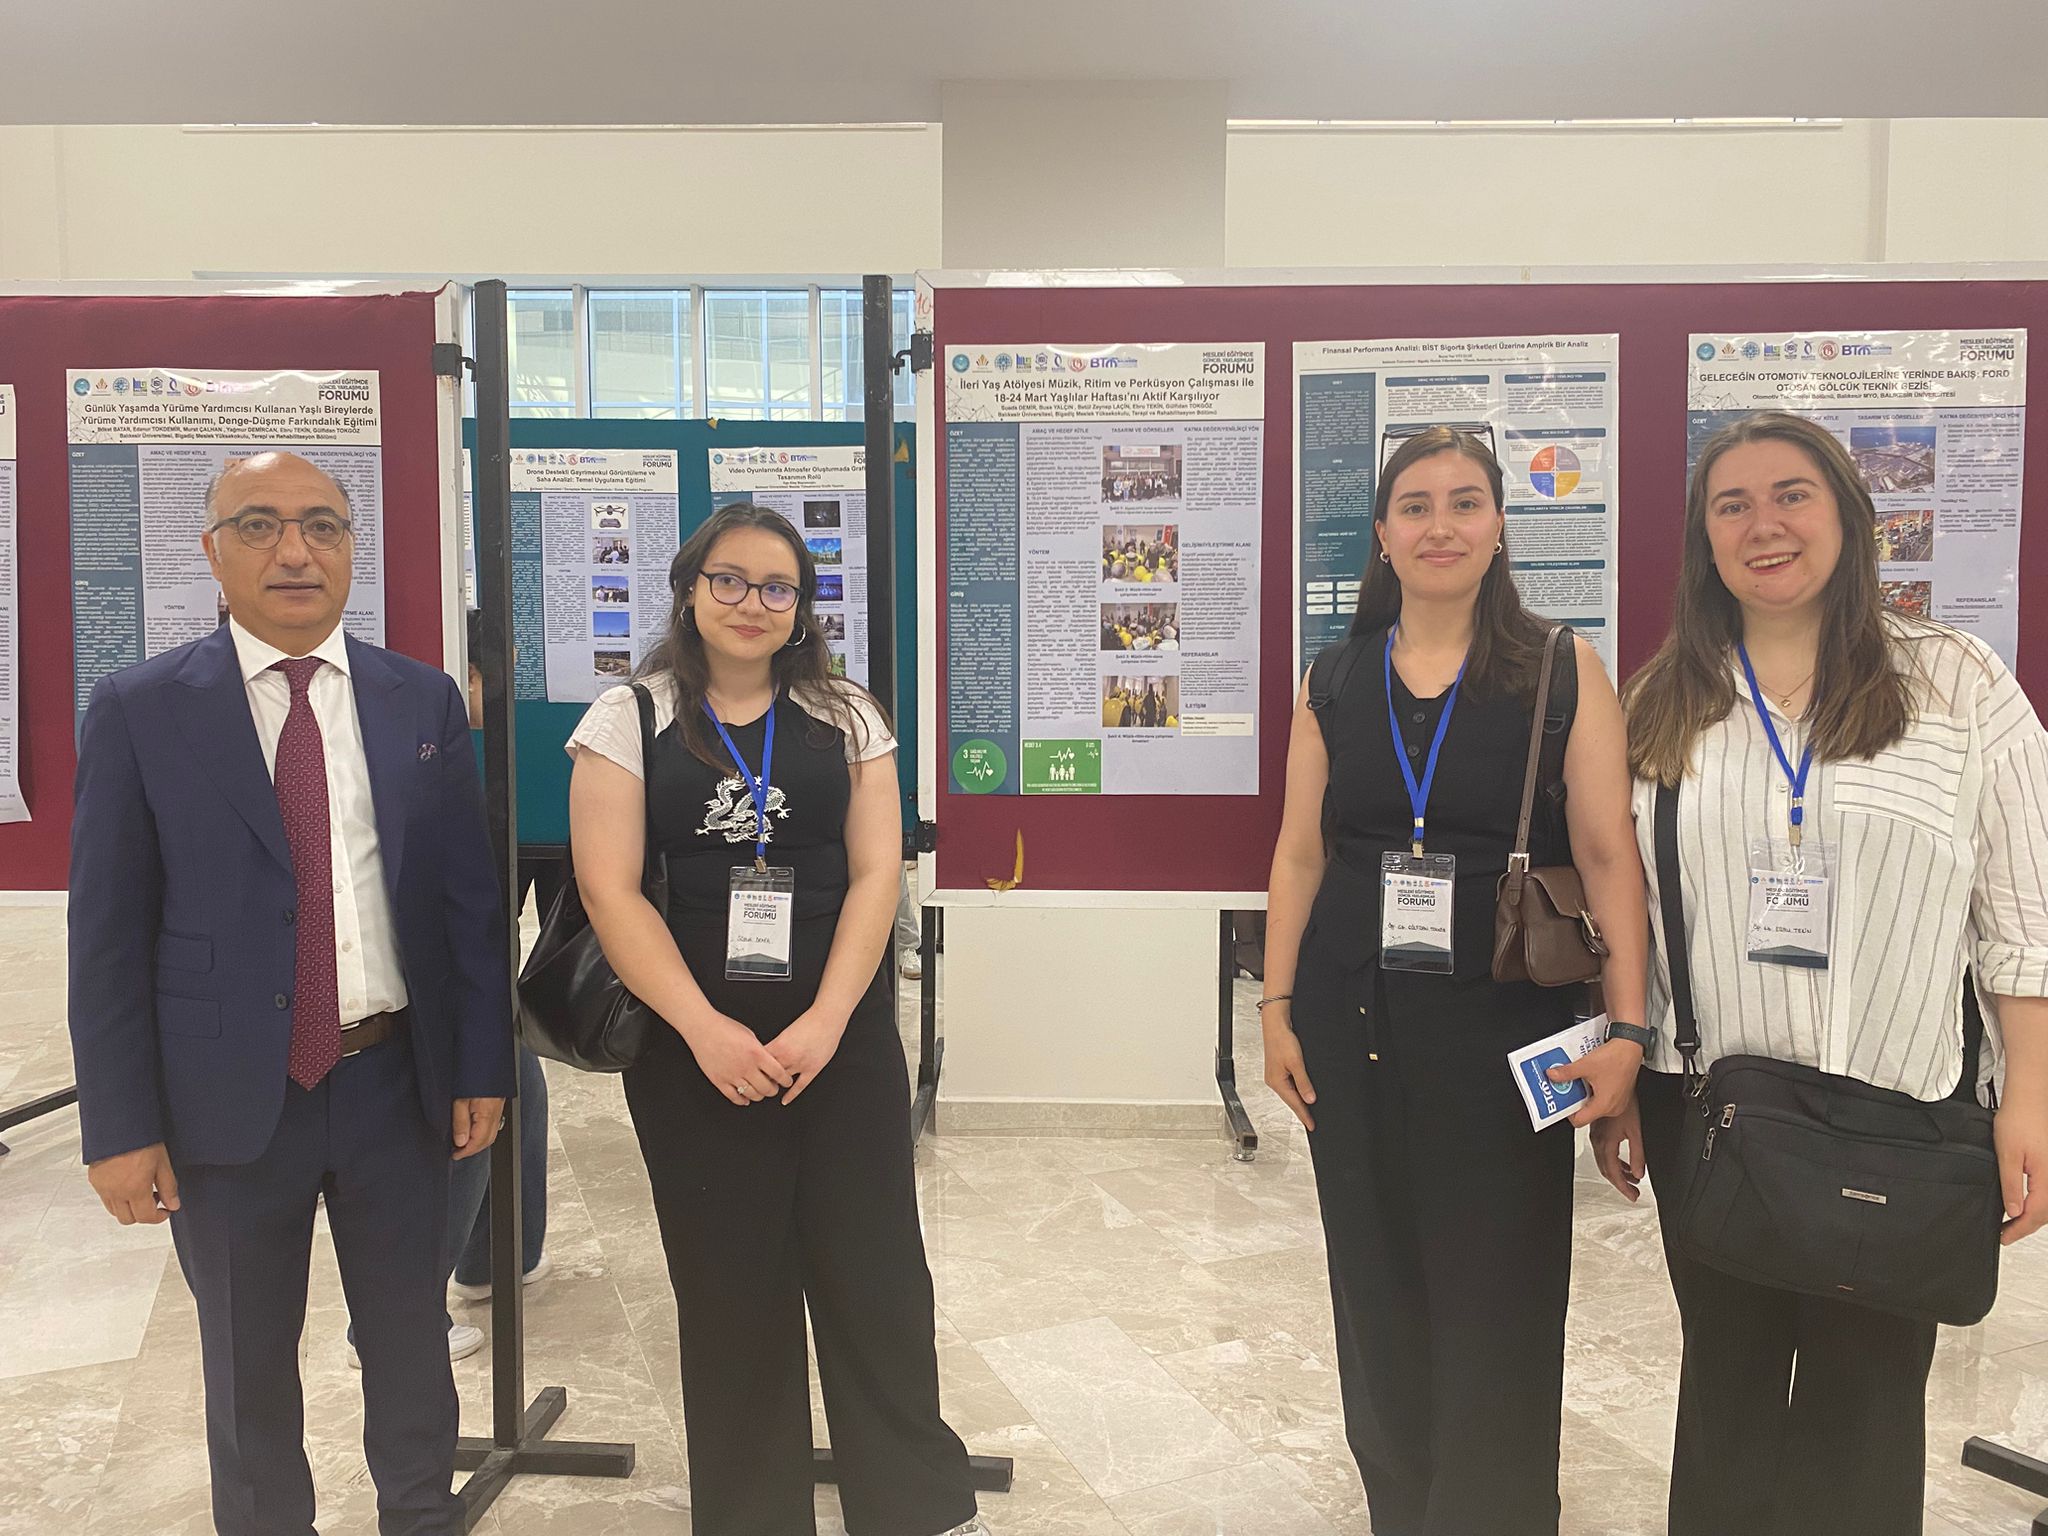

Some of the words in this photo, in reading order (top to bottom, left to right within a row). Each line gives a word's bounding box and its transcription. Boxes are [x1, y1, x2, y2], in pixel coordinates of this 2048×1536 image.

[1440, 344, 1465, 352] Sigorta
[1500, 342, 1525, 350] Üzerine
[1527, 342, 1553, 350] Ampirik
[1960, 350, 2014, 361] FORUMU
[1203, 364, 1254, 374] FORUMU
[1700, 372, 1755, 382] GELECEĞİN
[1758, 372, 1807, 381] OTOMOTİV
[1812, 370, 1899, 380] TEKNOLOJİLERİNE
[1903, 369, 1944, 379] YERİNDE
[1947, 370, 1979, 380] BAKIŞ:
[1982, 370, 2010, 378] FORD
[960, 378, 979, 389] İleri
[982, 380, 1000, 391] Yaş
[1004, 380, 1045, 391] Atölyesi
[1048, 379, 1081, 389] Müzik,
[1084, 379, 1111, 388] Ritim
[1130, 379, 1185, 389] Perküsyon
[1188, 378, 1239, 389] Çalışması
[1242, 378, 1254, 387] ile
[1776, 384, 1815, 392] OTOSAN
[1819, 382, 1859, 391] GÖLCÜK
[1863, 381, 1898, 390] TEKNİK
[1901, 380, 1932, 390] GEZİSİ
[318, 391, 370, 401] FORUMU
[994, 394, 1021, 403] 18-24
[1025, 394, 1047, 402] Mart
[1050, 392, 1088, 404] Yaşlılar
[1092, 392, 1140, 402] Haftası'nı
[1143, 392, 1167, 401] Aktif
[1170, 392, 1220, 403] Karşılıyor
[85, 404, 117, 413] Günlük
[119, 404, 160, 414] Yaşamda
[162, 404, 199, 413] Yürüme
[202, 404, 252, 413] Yardımcısı
[255, 405, 297, 414] Kullanan
[300, 406, 322, 415] Yaşlı
[324, 406, 374, 416] Bireylerde
[82, 416, 117, 425] Yürüme
[118, 416, 166, 425] Yardımcısı
[169, 416, 216, 426] Kullanımı,
[219, 417, 285, 427] Denge-Düşme
[288, 417, 341, 426] Farkındalık
[344, 418, 377, 428] Eğitimi
[571, 469, 608, 477] Gayrimenkul
[963, 749, 969, 759] 3
[1398, 898, 1436, 907] FORUMU
[1766, 897, 1809, 906] FOUMU
[744, 911, 777, 920] FORUMU
